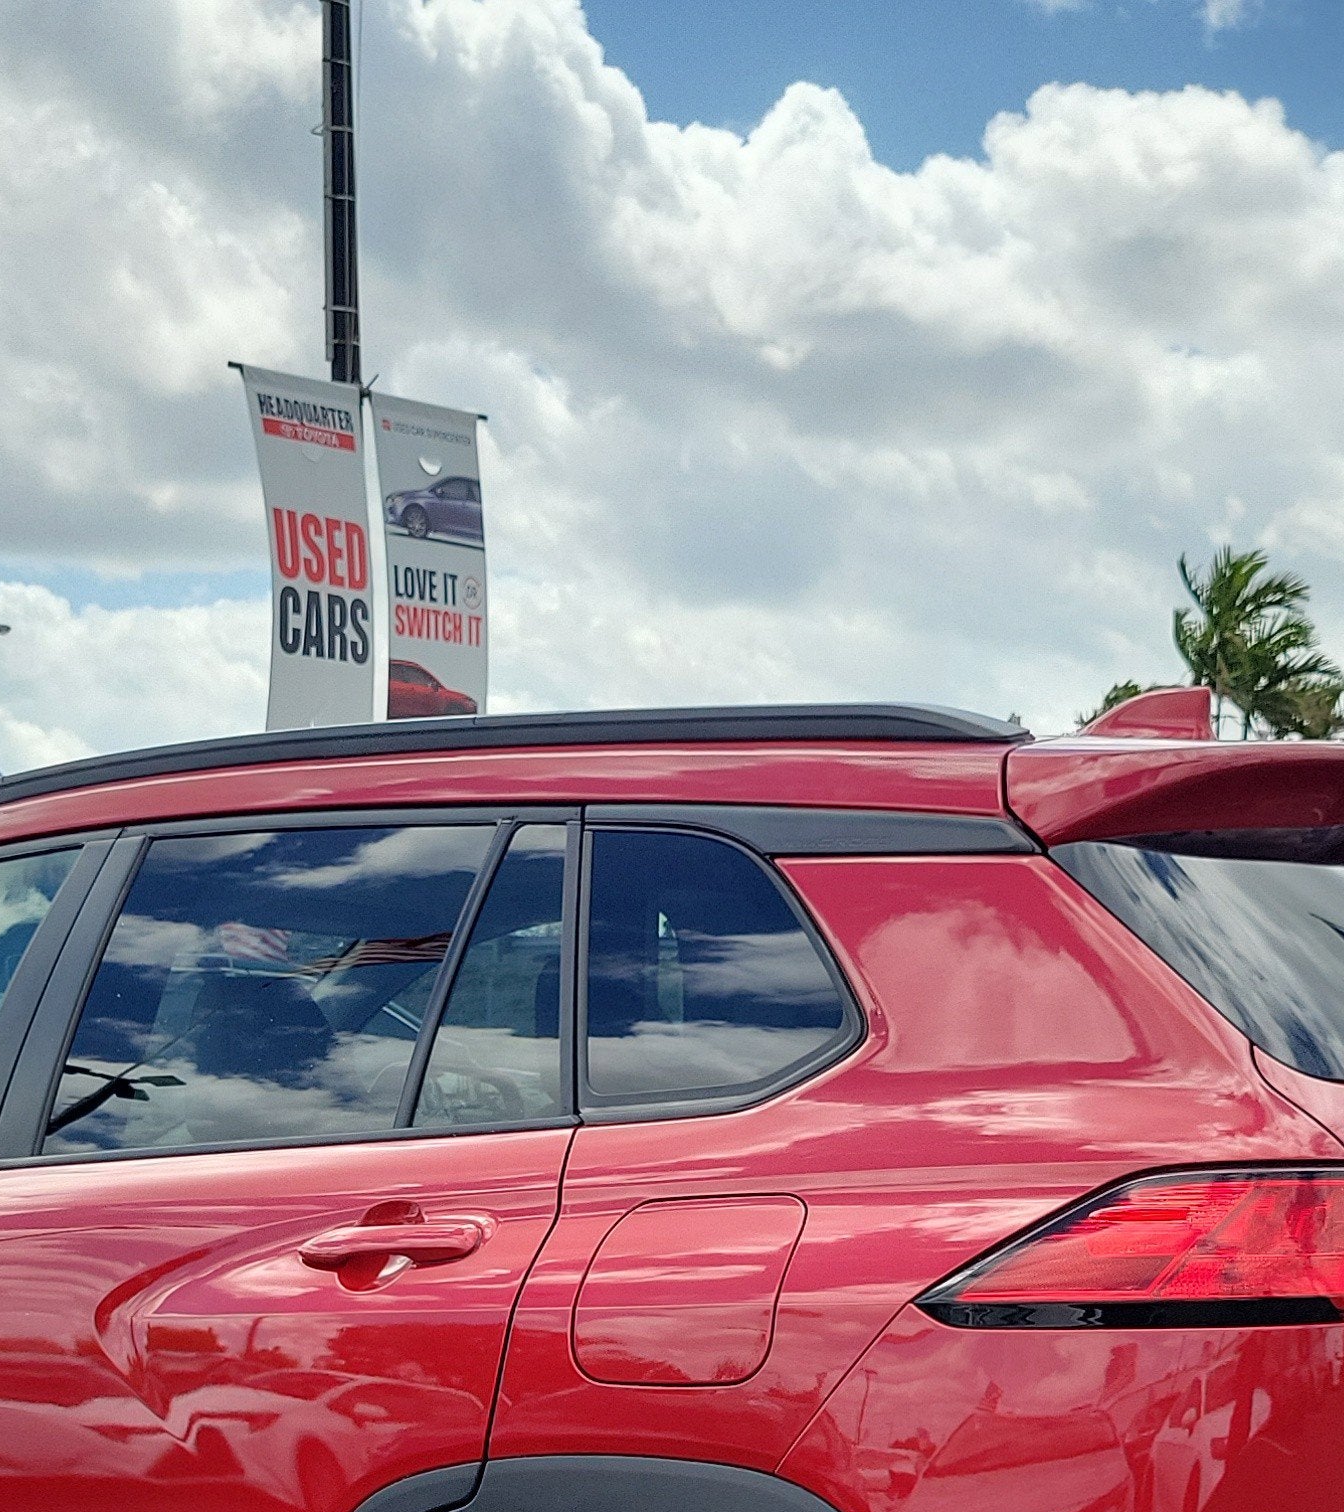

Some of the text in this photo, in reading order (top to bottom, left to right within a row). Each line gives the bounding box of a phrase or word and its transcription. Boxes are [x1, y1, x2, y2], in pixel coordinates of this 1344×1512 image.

[257, 393, 354, 433] HEADQUARTER
[273, 507, 367, 591] USED
[394, 565, 437, 603] LOVE
[444, 572, 458, 606] IT
[279, 586, 369, 664] CARS
[396, 604, 482, 647] SWITCH IT
